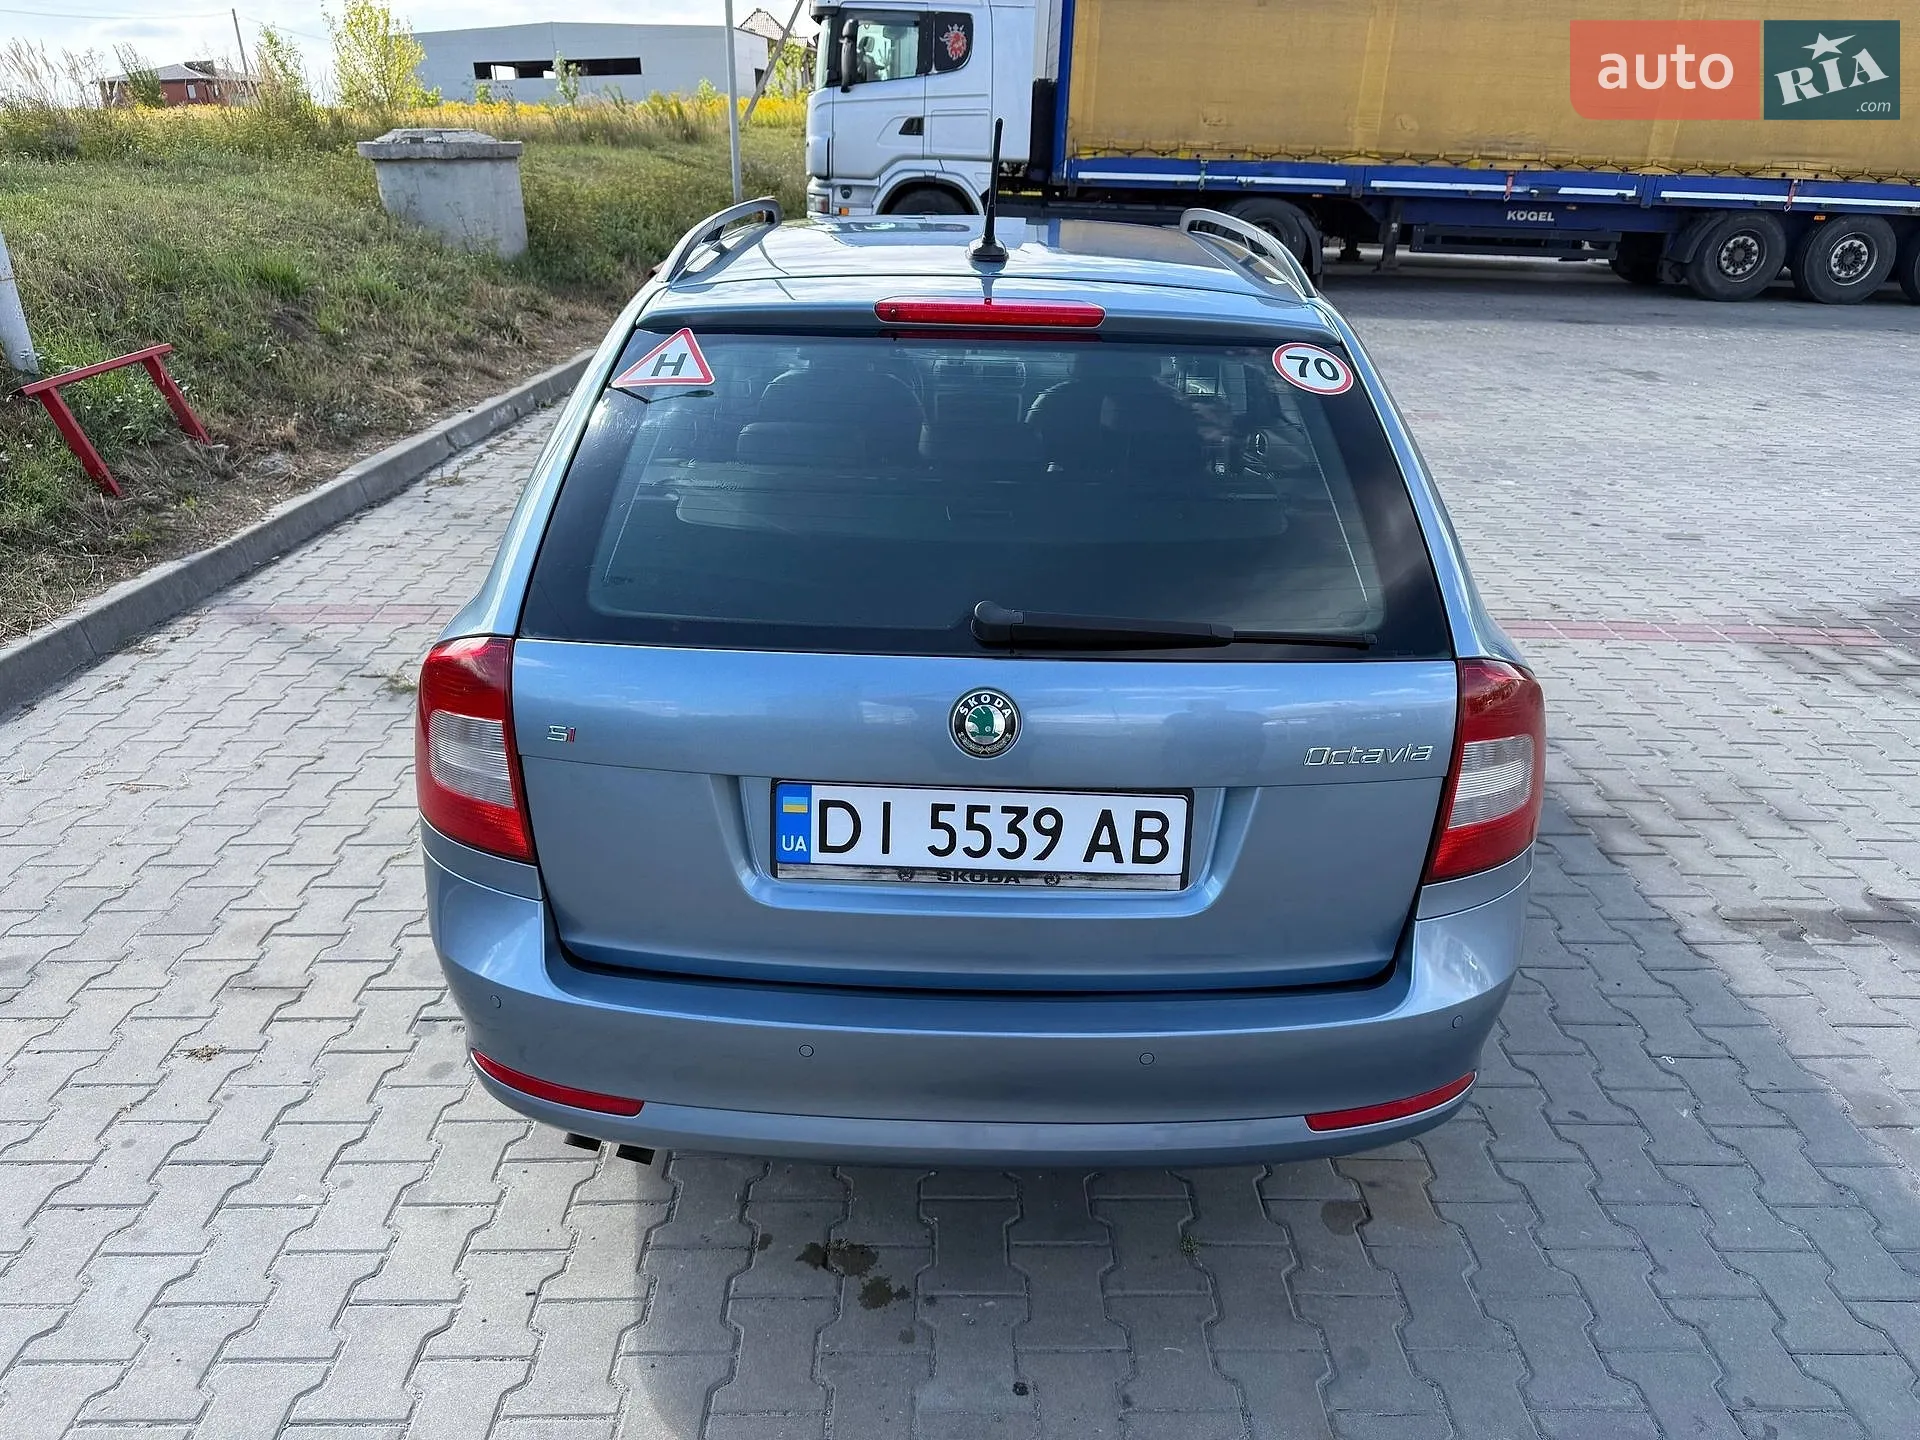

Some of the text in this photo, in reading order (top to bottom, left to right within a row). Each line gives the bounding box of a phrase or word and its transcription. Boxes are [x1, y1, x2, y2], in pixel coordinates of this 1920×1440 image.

[1285, 354, 1340, 381] 70
[1303, 743, 1434, 766] Octavia
[781, 834, 808, 852] UA
[818, 799, 1170, 865] DI 5539 AB
